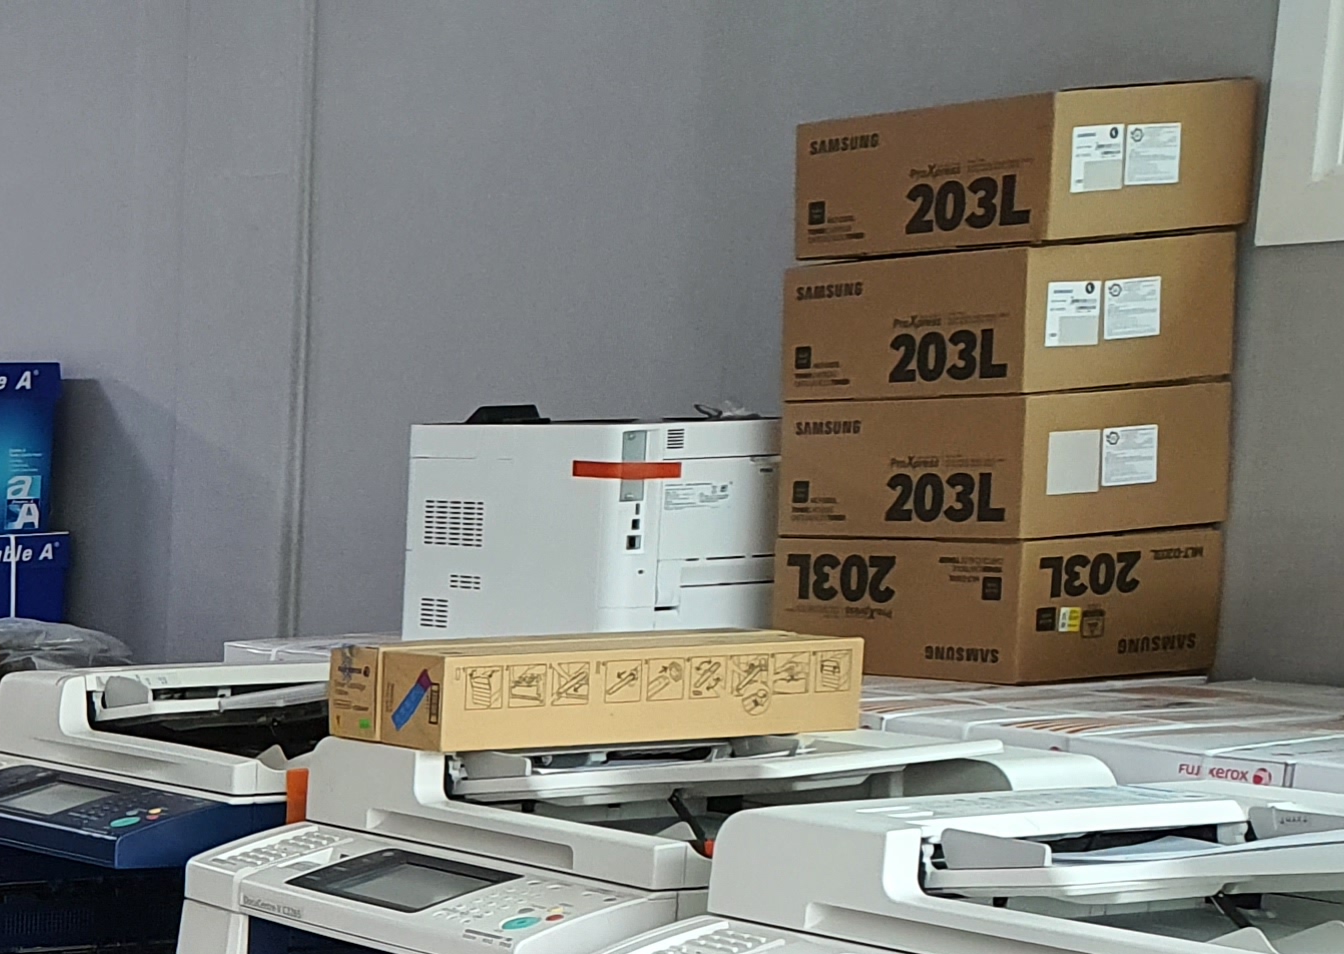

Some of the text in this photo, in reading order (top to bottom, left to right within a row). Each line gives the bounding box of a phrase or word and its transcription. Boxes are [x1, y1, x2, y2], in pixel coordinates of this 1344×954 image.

[809, 133, 880, 155] SAMSUNG
[905, 174, 1031, 235] 203L
[796, 282, 864, 300] SAMSUNG
[889, 328, 1008, 383] 203L
[796, 420, 861, 435] SAMSUNG
[884, 472, 1006, 522] 203L
[786, 553, 897, 603] 203L
[1039, 550, 1142, 598] 203L
[1117, 633, 1197, 655] SAMSUNG
[925, 646, 999, 665] SAMSUNG
[1178, 763, 1202, 776] FUJ
